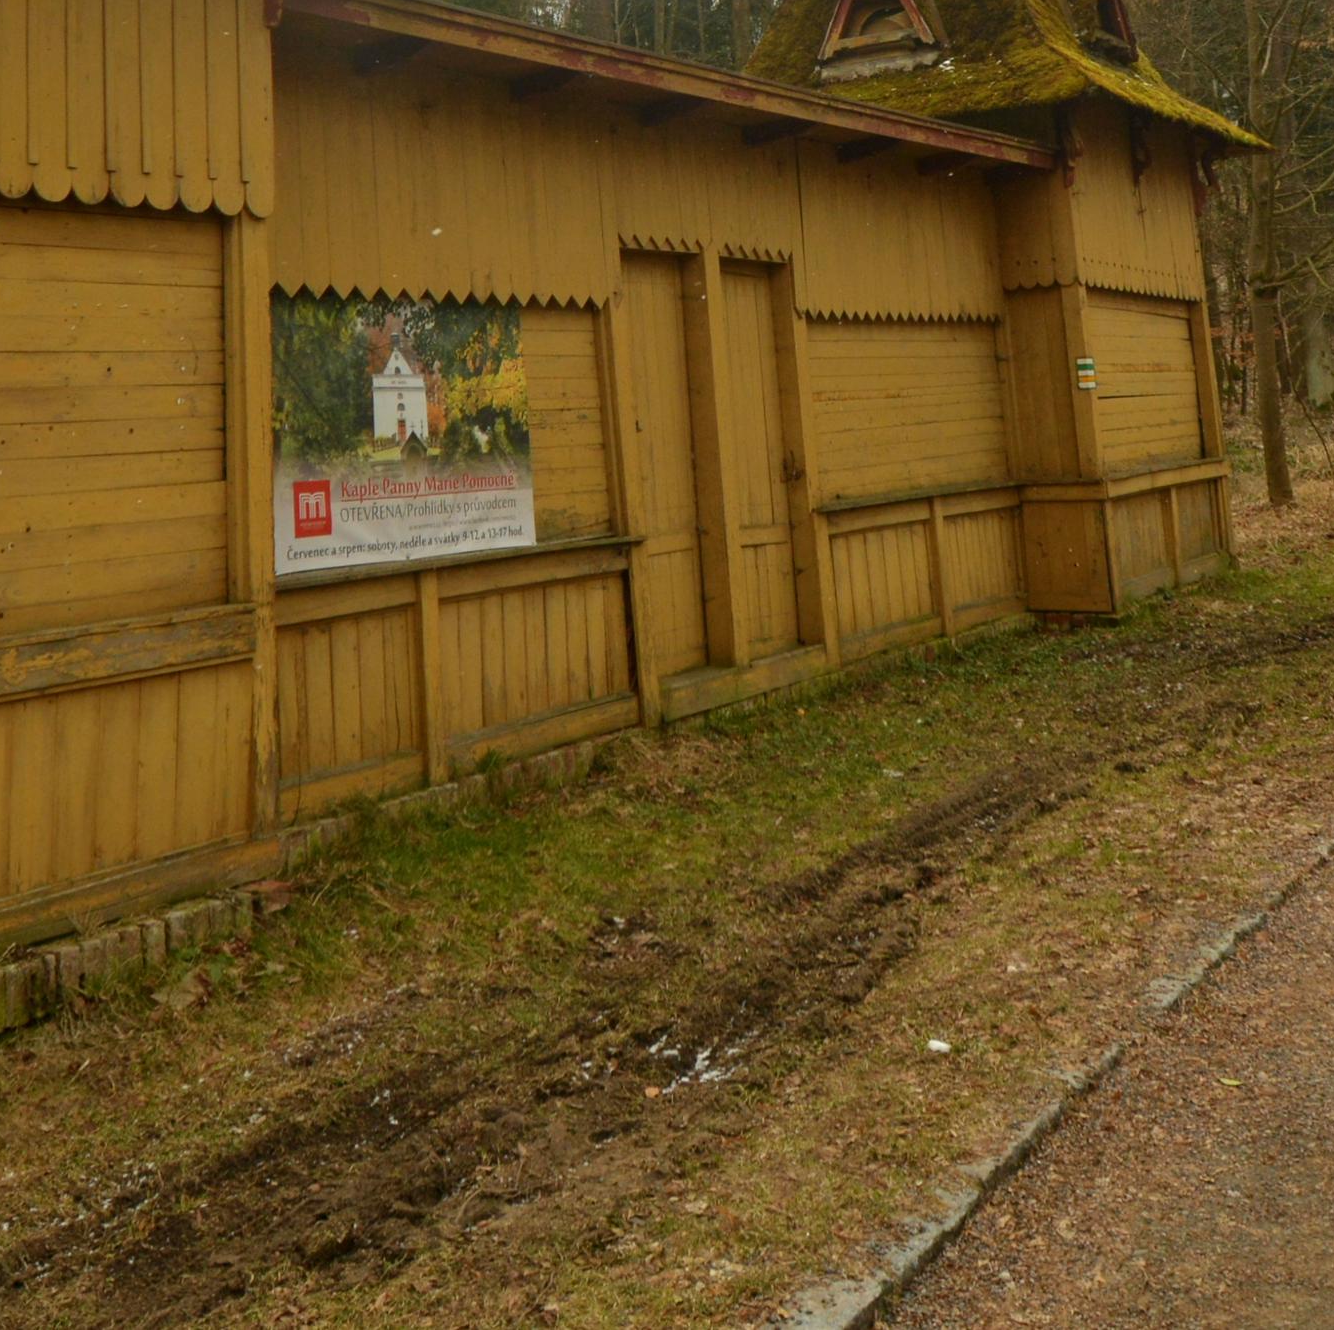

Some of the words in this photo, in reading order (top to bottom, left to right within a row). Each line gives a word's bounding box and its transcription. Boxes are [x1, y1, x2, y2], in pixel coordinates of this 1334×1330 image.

[341, 477, 379, 503] Kaple
[383, 477, 422, 499] Panny
[425, 475, 459, 492] Marie
[462, 471, 515, 488] Pomocné
[463, 494, 517, 516] průvodcem
[287, 545, 329, 560] Červenec
[331, 548, 336, 556] a
[338, 543, 366, 558] srpen:
[367, 538, 398, 552] soboty,
[400, 536, 427, 549] neděle
[435, 533, 461, 546] svátky
